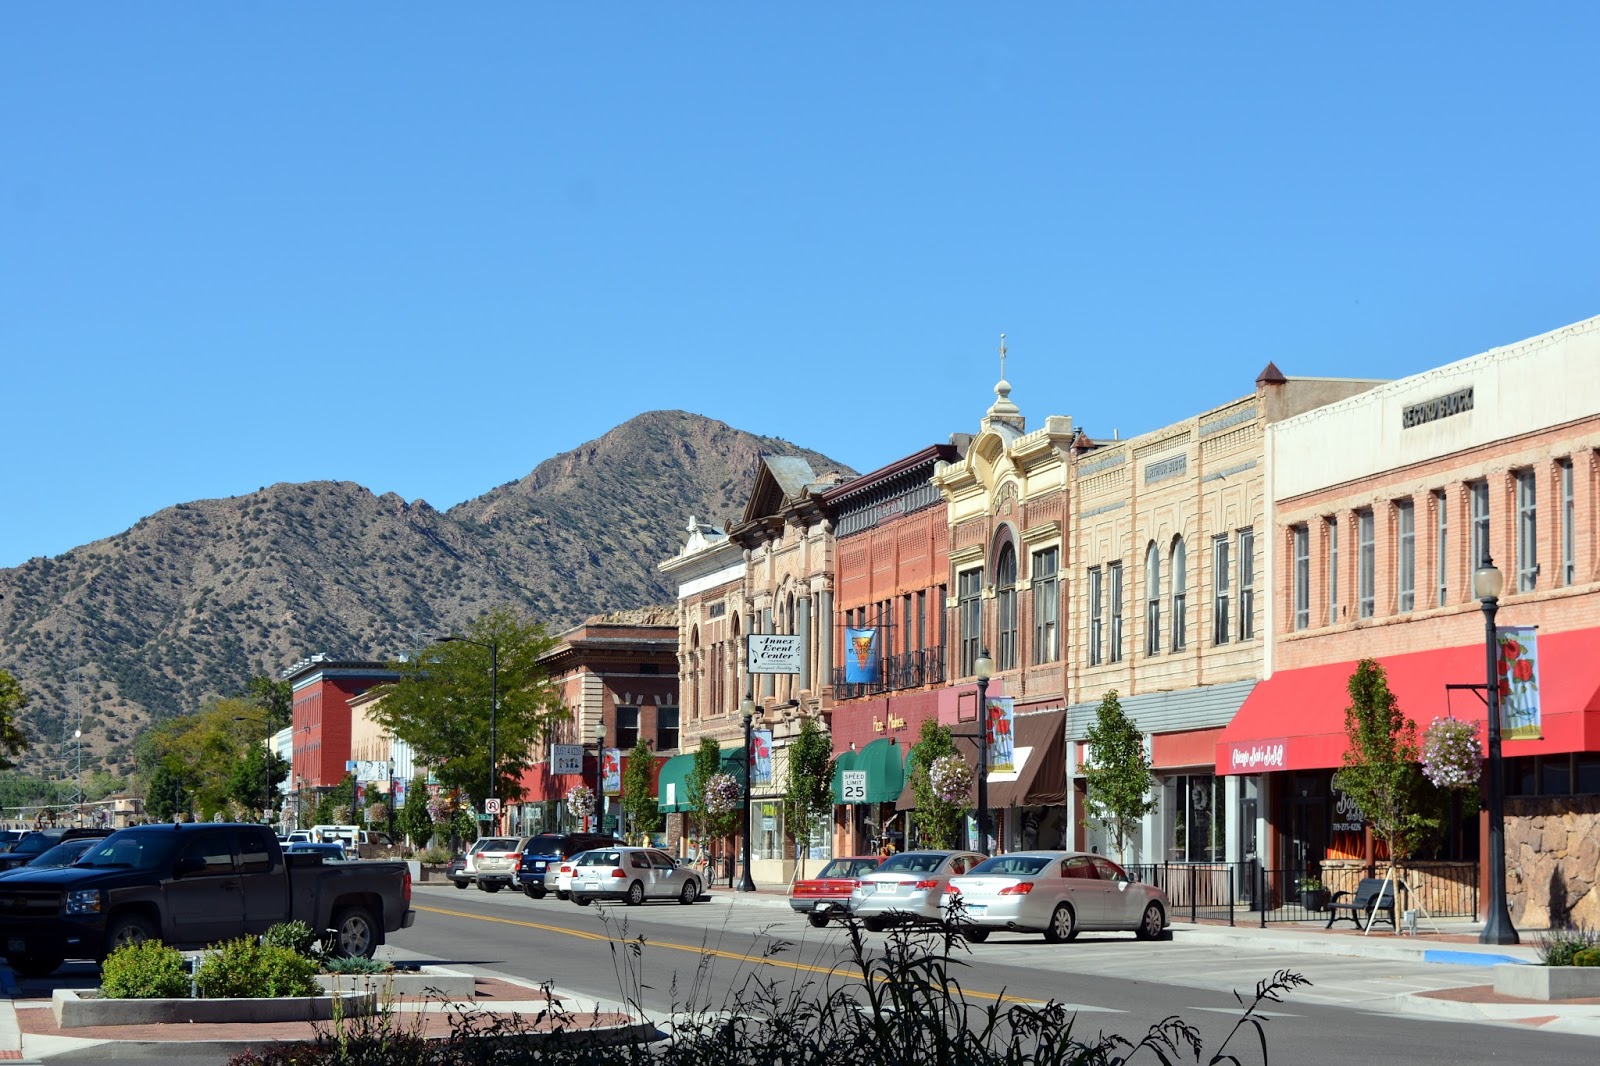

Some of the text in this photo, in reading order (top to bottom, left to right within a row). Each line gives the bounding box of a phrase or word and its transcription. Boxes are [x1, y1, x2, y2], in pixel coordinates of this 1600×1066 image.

[1440, 387, 1474, 418] BLOCK
[760, 637, 794, 645] Annex
[761, 652, 794, 660] Center
[844, 786, 865, 797] 25
